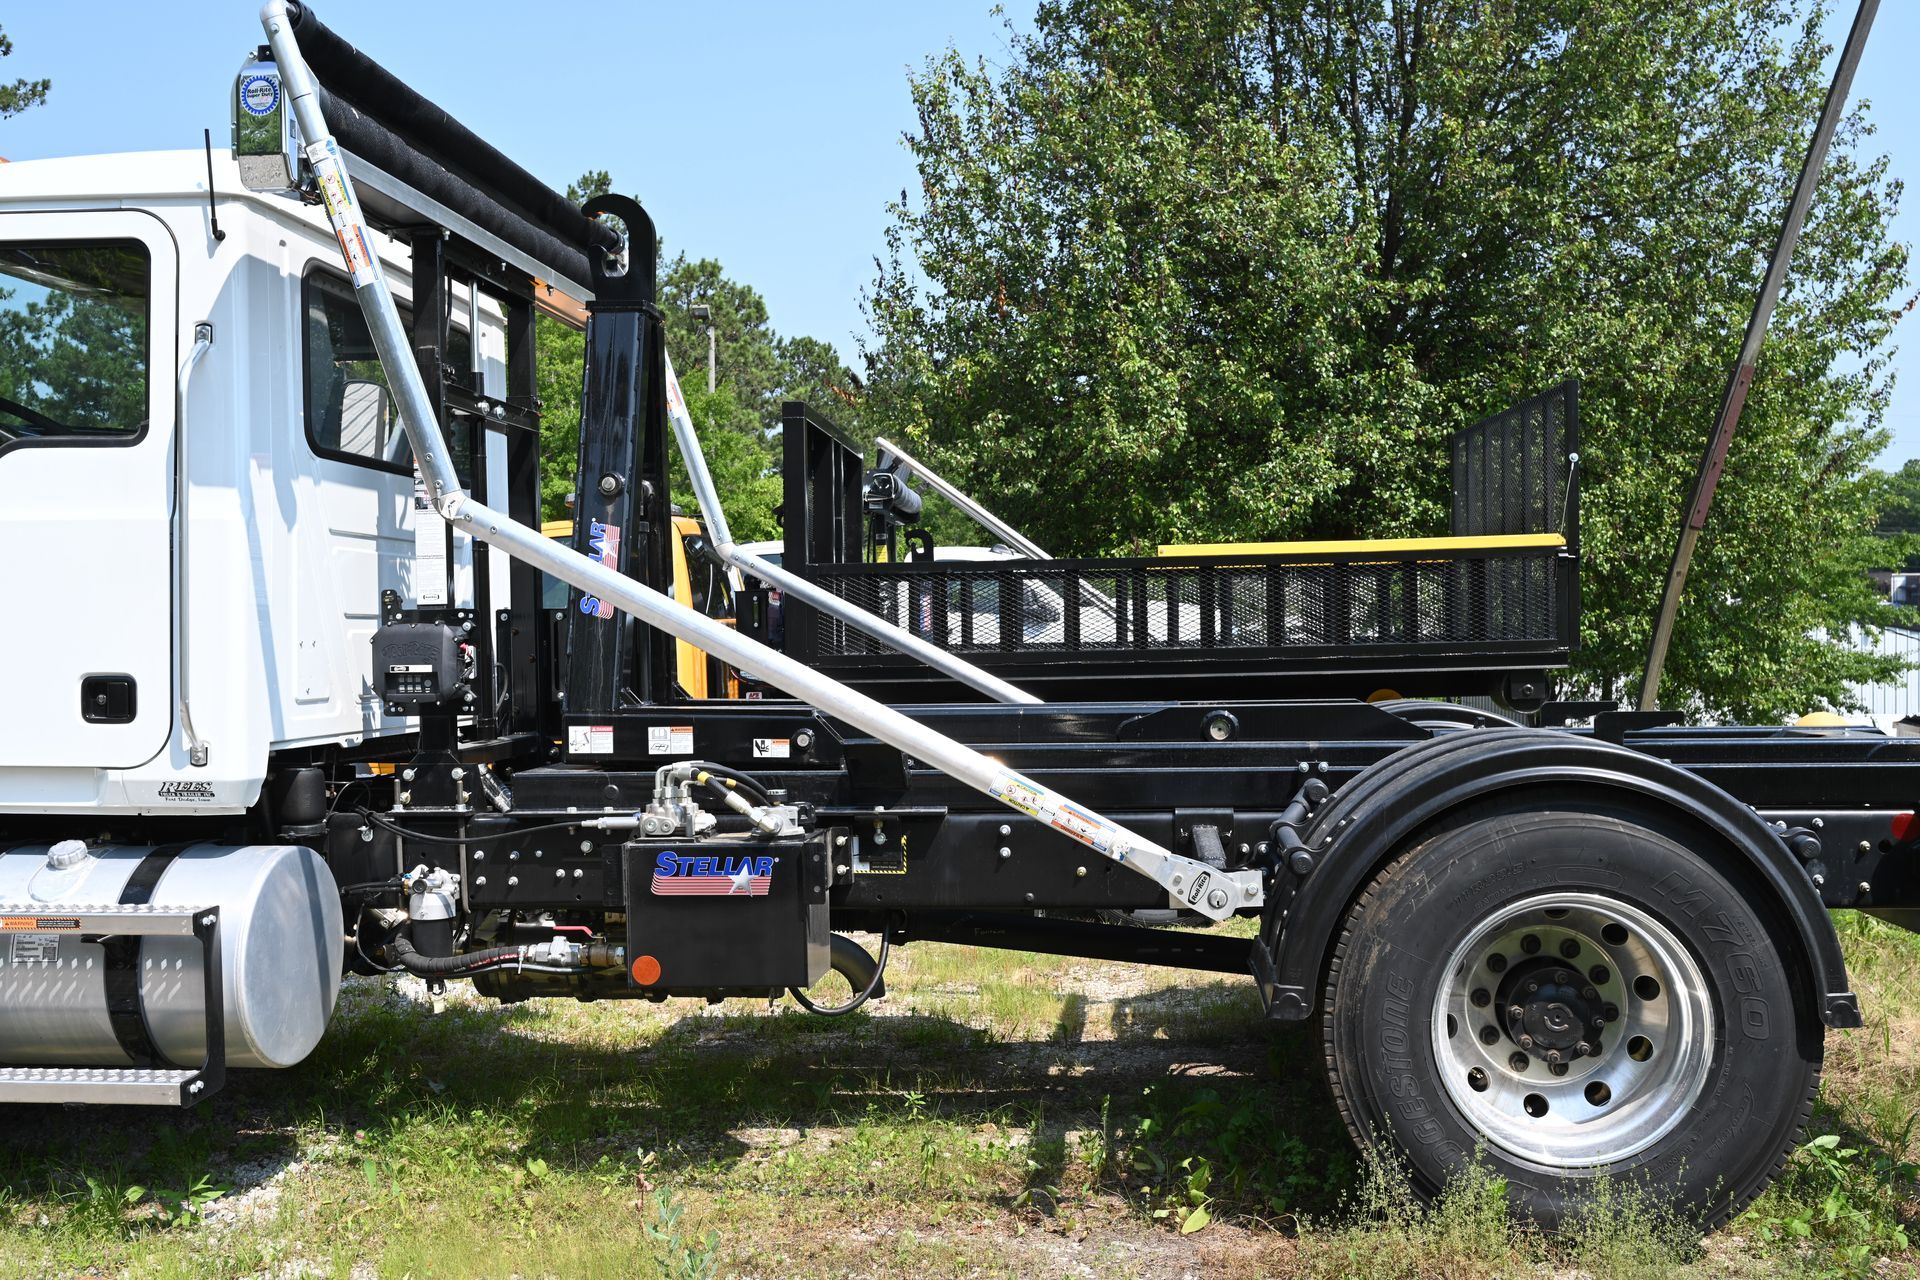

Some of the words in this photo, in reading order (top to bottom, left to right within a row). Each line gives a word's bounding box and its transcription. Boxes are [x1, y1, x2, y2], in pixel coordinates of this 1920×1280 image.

[579, 521, 606, 617] SLAR
[160, 781, 213, 792] REES
[654, 851, 774, 876] STELLAR
[1191, 876, 1208, 901] Roll-Rite
[1651, 870, 1771, 1040] M760
